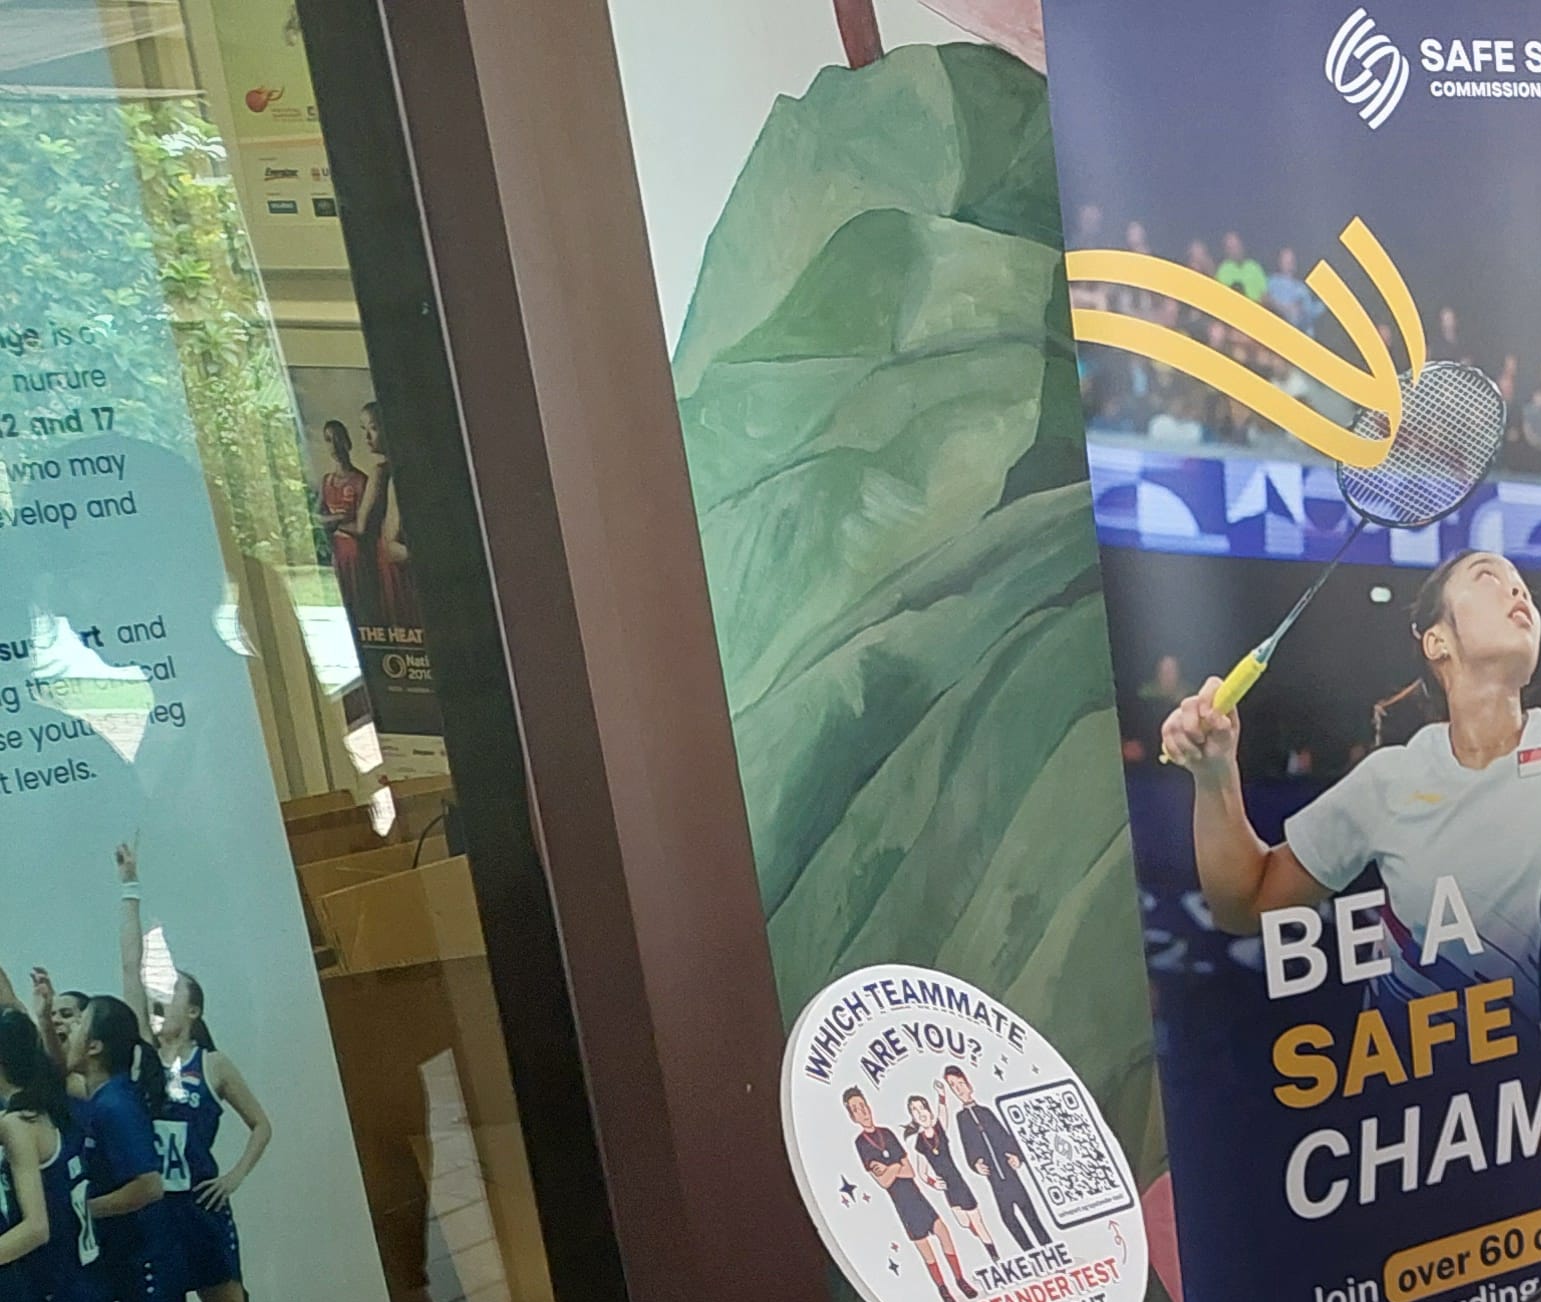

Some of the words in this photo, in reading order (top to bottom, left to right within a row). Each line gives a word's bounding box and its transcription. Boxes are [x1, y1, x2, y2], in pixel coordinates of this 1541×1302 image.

[1420, 38, 1514, 74] SAFE
[1430, 81, 1541, 99] COMMISSION
[52, 321, 72, 346] is
[32, 408, 84, 436] and
[91, 406, 115, 431] 17
[69, 455, 126, 481] may
[87, 491, 138, 519] and
[117, 614, 167, 645] and
[358, 626, 386, 643] THE
[389, 627, 426, 644] HEAT
[15, 757, 98, 792] levels.
[1260, 889, 1392, 1000] BE
[1420, 874, 1485, 967] A
[805, 991, 871, 1081] WHICH
[862, 979, 1028, 1050] TEAMMATE
[1272, 977, 1519, 1109] SAFE
[861, 1027, 908, 1085] ARE
[902, 1022, 982, 1064] YOU?
[976, 1259, 1033, 1291] TAKE
[1029, 1243, 1073, 1273] THE
[1070, 1258, 1121, 1291] TEST
[1398, 1250, 1472, 1293] over
[1479, 1228, 1525, 1268] 60
